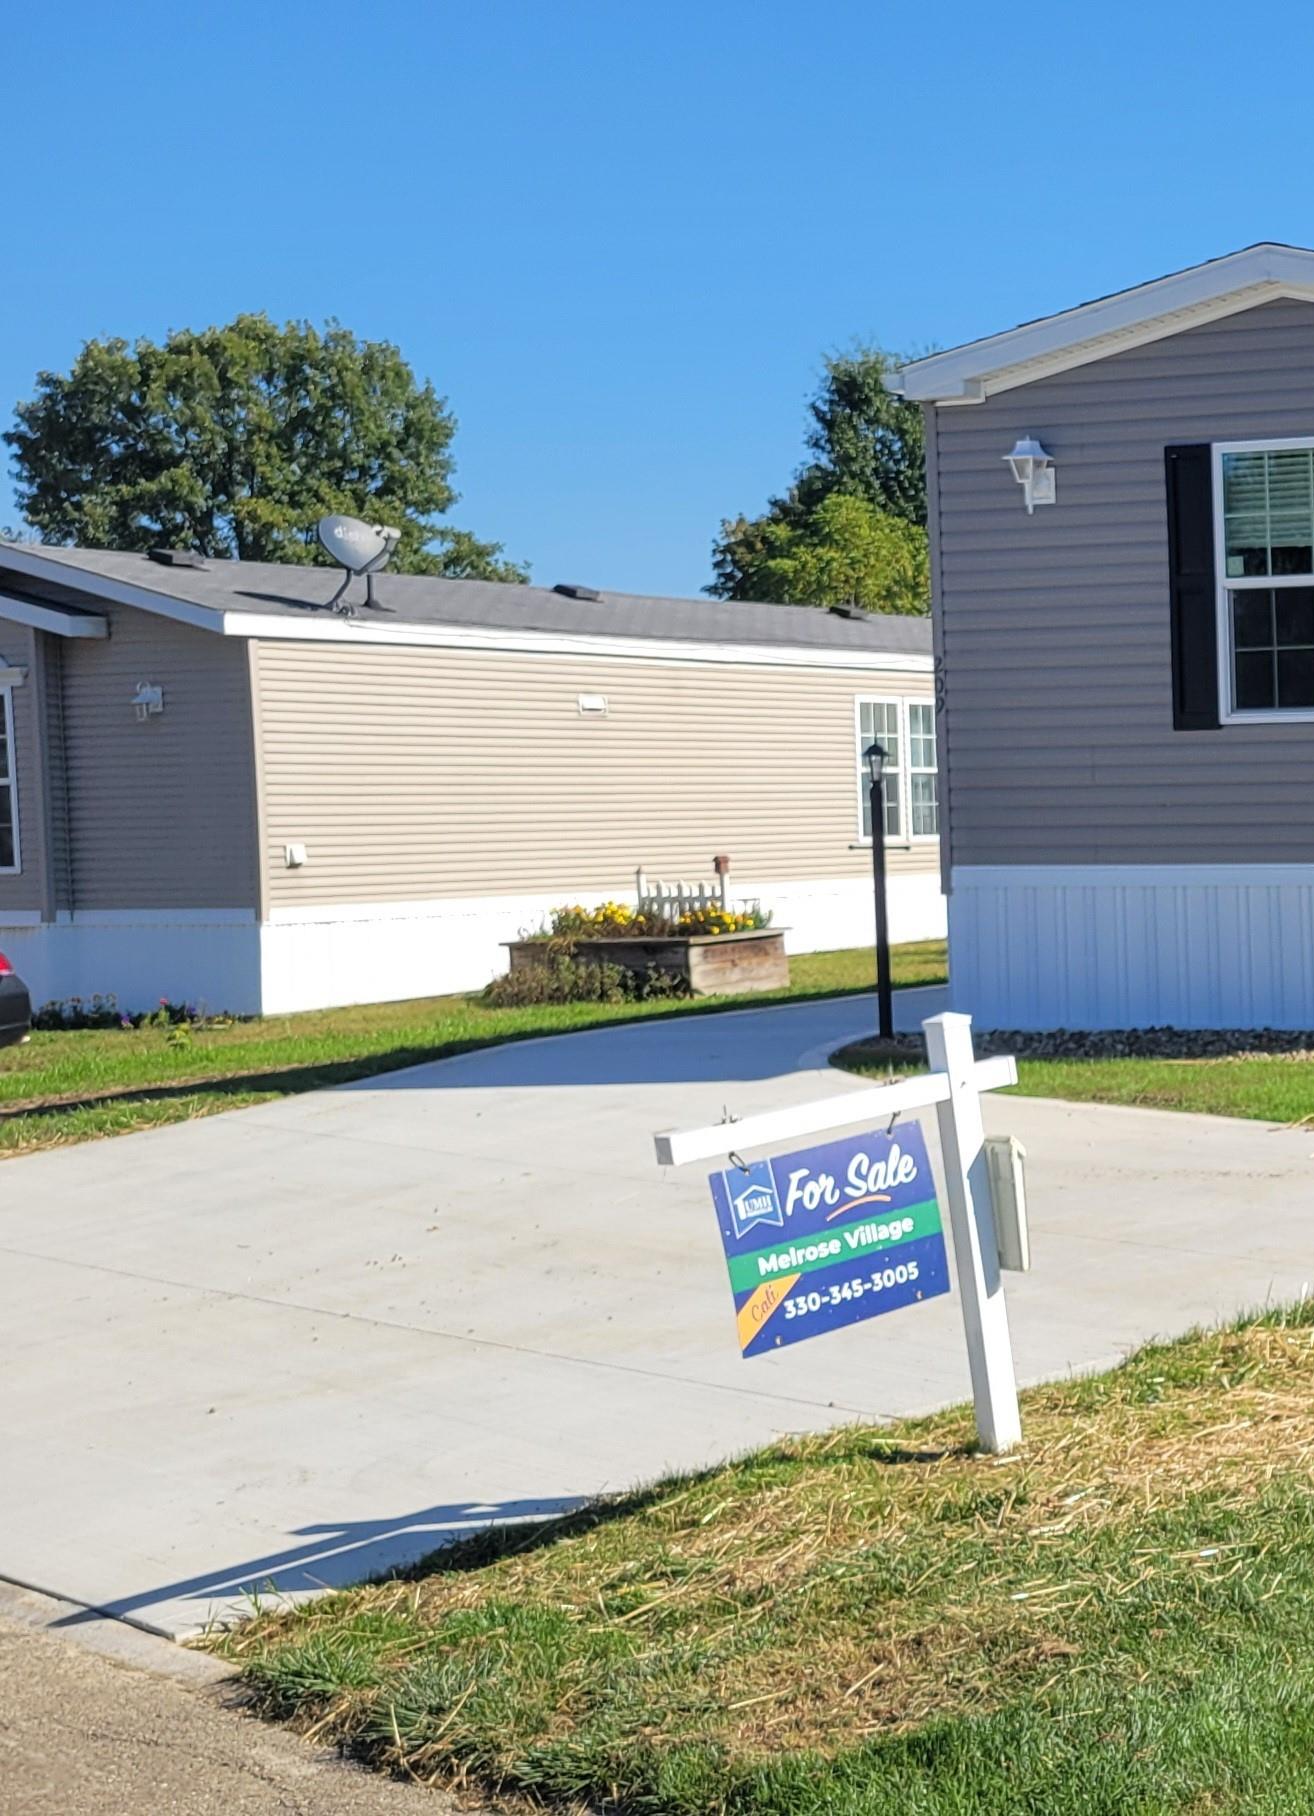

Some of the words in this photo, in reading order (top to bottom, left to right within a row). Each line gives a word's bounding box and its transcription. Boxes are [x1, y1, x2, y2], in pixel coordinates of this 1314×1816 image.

[786, 1168, 840, 1216] For
[844, 1143, 917, 1197] Sale
[758, 1238, 842, 1276] Melrose
[843, 1217, 914, 1249] Village
[784, 1261, 919, 1319] 330-345-3005
